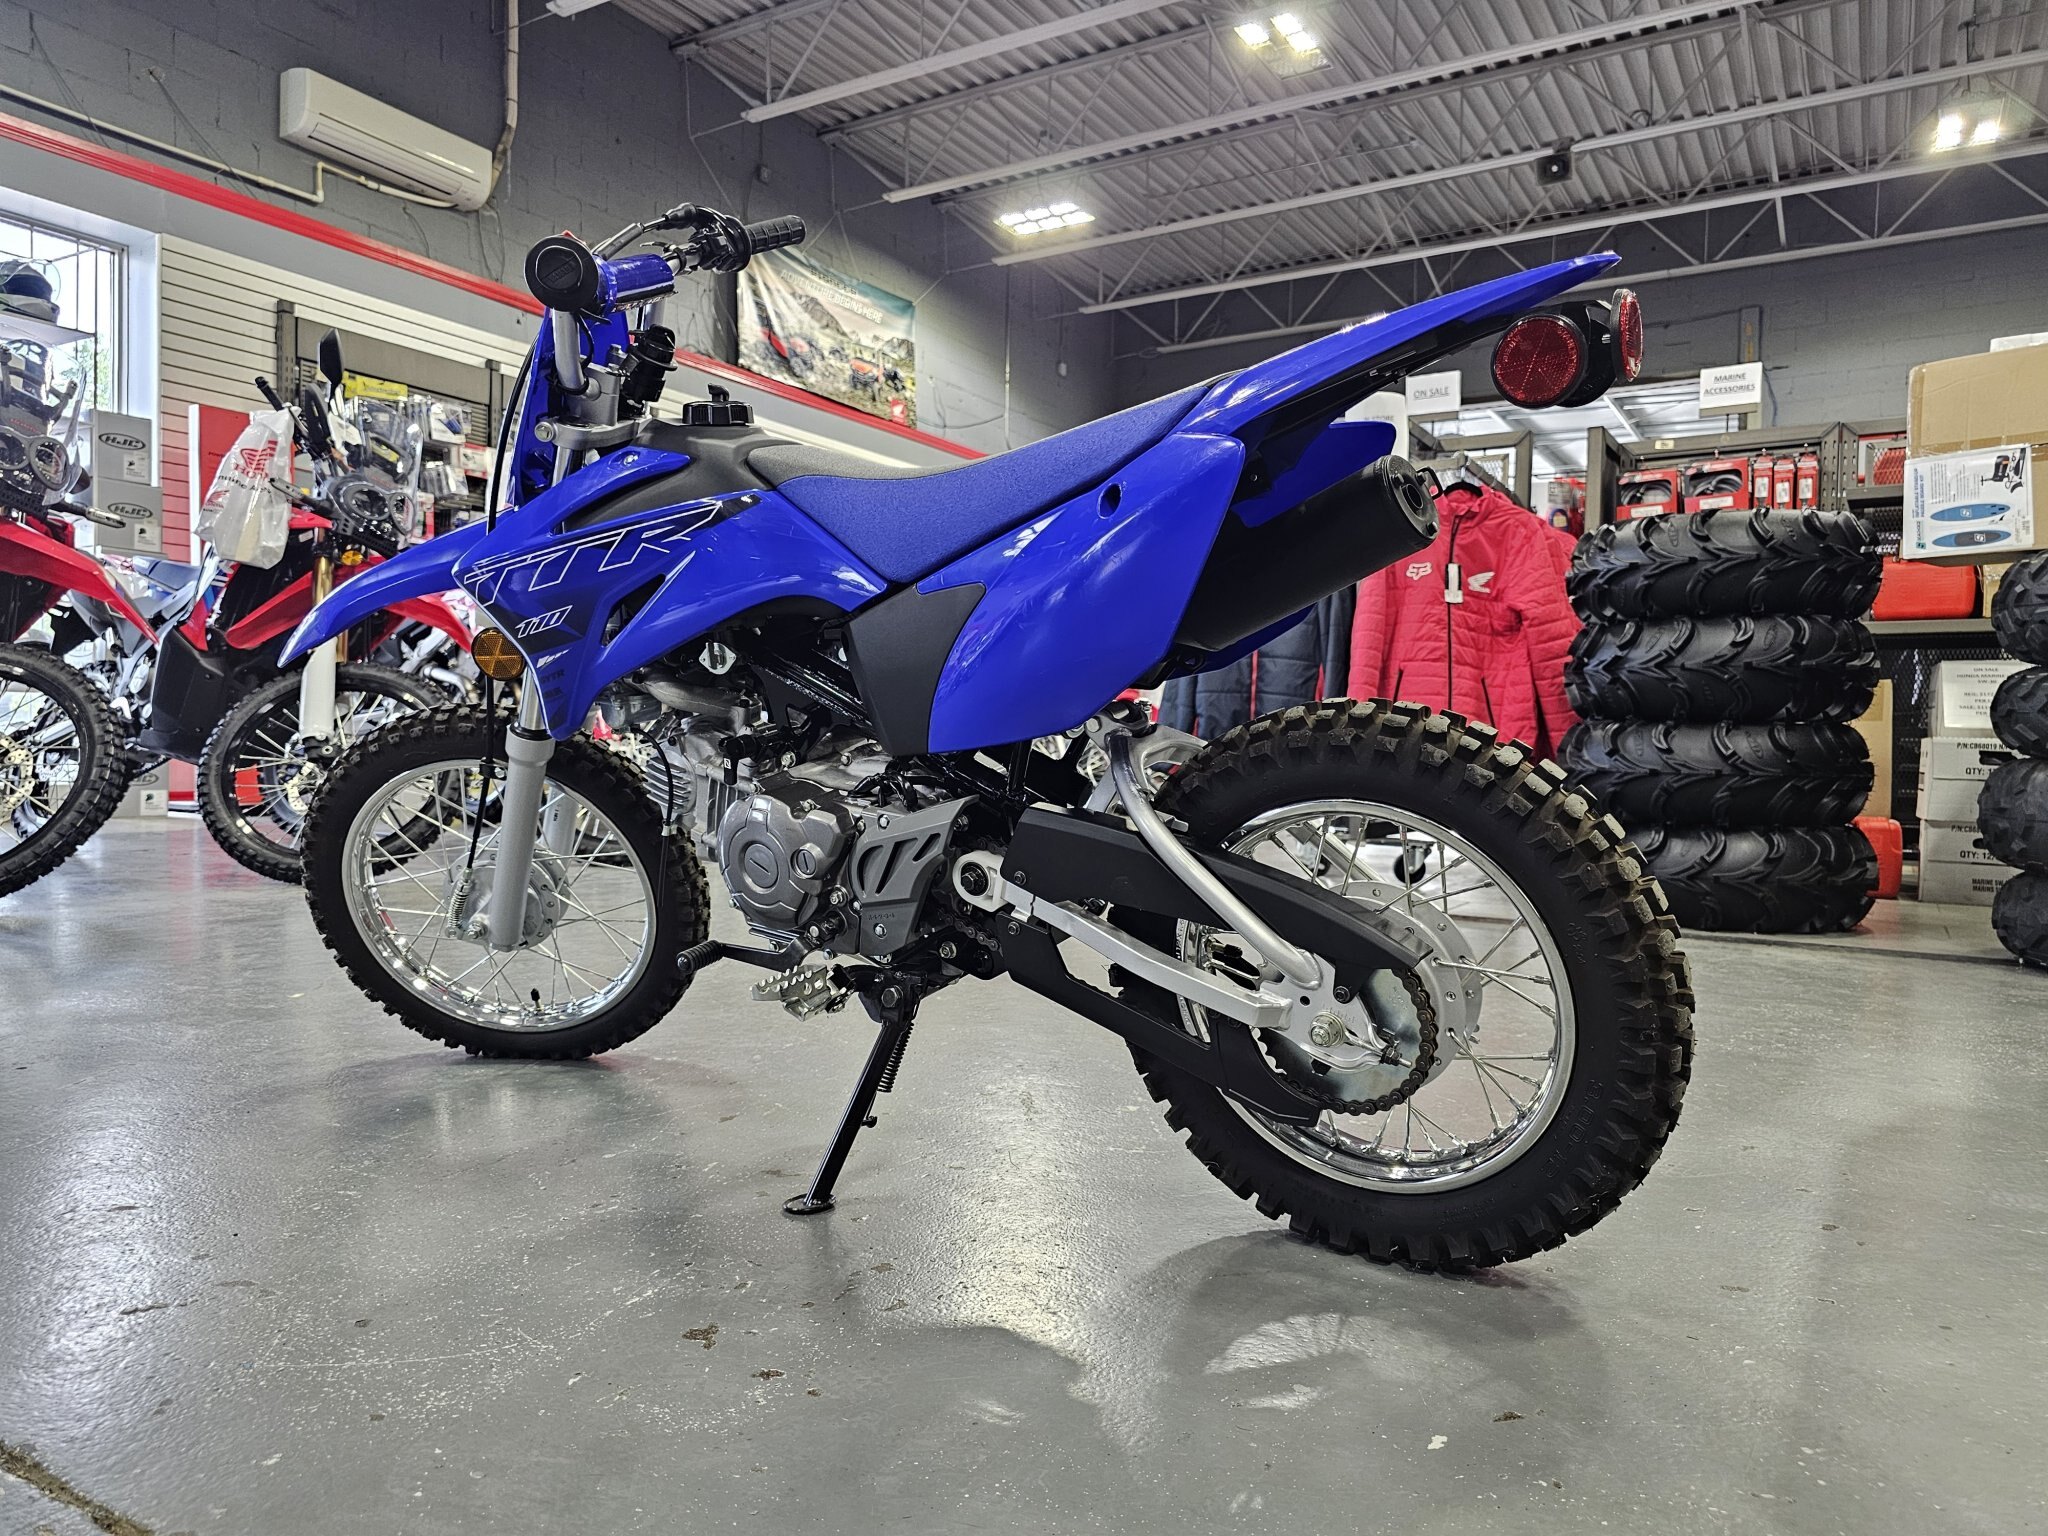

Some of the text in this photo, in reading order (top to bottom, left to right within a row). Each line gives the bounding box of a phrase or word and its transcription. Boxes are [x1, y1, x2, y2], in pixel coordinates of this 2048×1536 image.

[862, 306, 883, 324] HERE
[1704, 372, 1756, 394] MARINE ACCESSORIES
[1413, 386, 1449, 399] ON SALE
[104, 436, 141, 448] HJC
[114, 505, 148, 517] HJC
[515, 604, 573, 638] 110
[1965, 767, 1985, 775] QTY:
[1960, 850, 1979, 859] QTY:
[1972, 878, 1993, 886] MARINE
